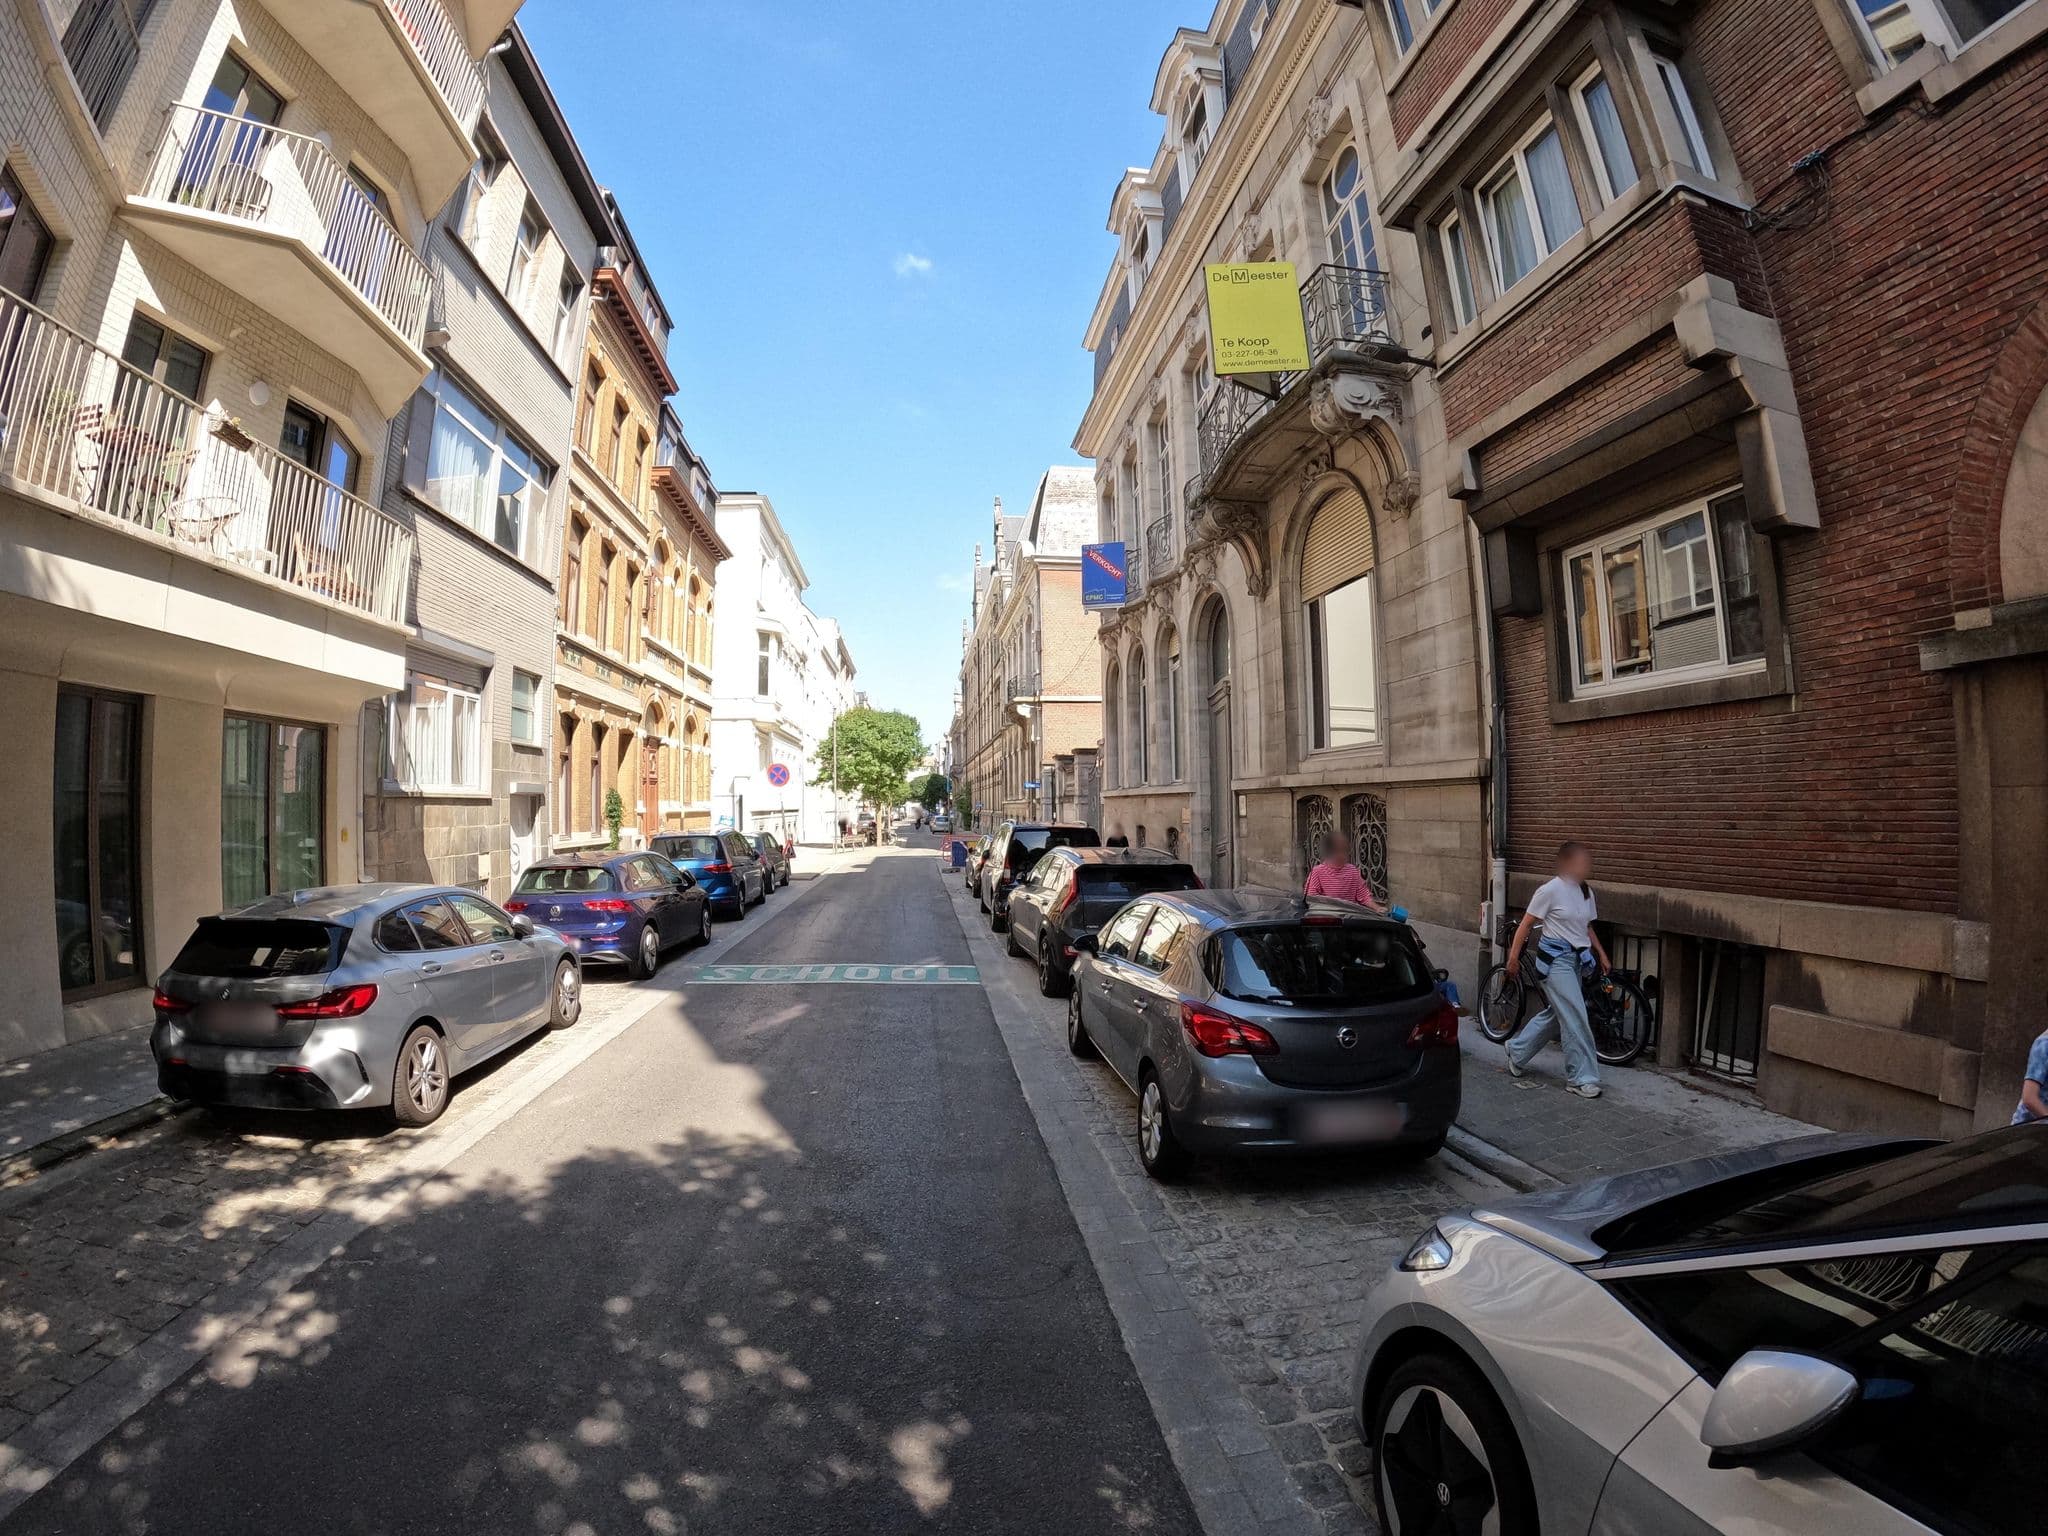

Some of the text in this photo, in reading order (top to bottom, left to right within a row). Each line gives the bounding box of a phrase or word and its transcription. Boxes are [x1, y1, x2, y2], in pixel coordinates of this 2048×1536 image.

[1220, 337, 1270, 348] Te Koop
[1222, 357, 1302, 367] www.demeester.eu
[1089, 551, 1121, 577] VERKOCHT
[703, 966, 968, 981] SCHOOL
